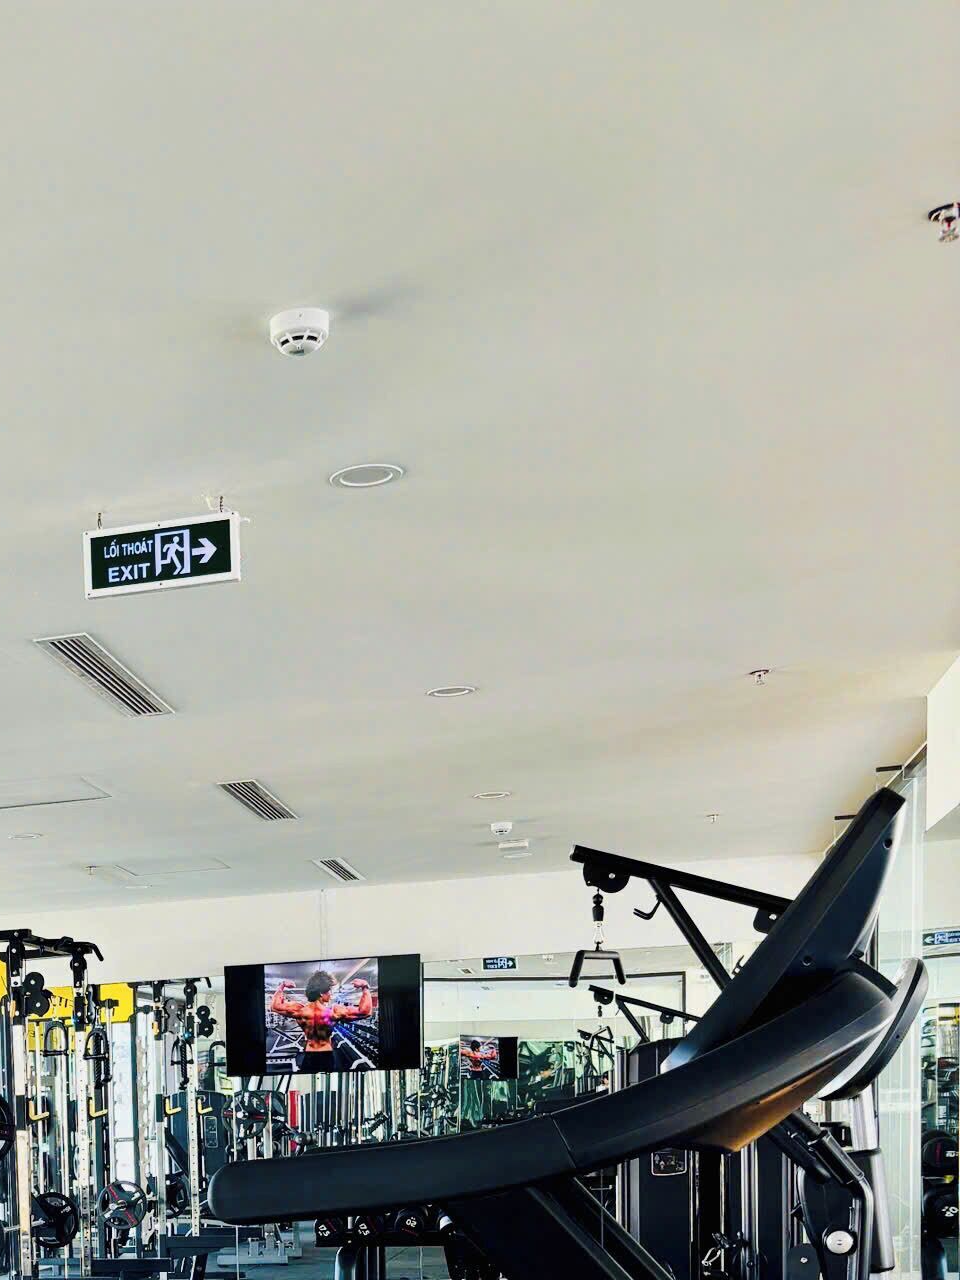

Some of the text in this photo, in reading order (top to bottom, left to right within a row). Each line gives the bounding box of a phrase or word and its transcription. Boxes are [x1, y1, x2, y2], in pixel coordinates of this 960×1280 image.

[103, 537, 154, 559] LỐI THOÁT
[108, 562, 150, 583] EXIT
